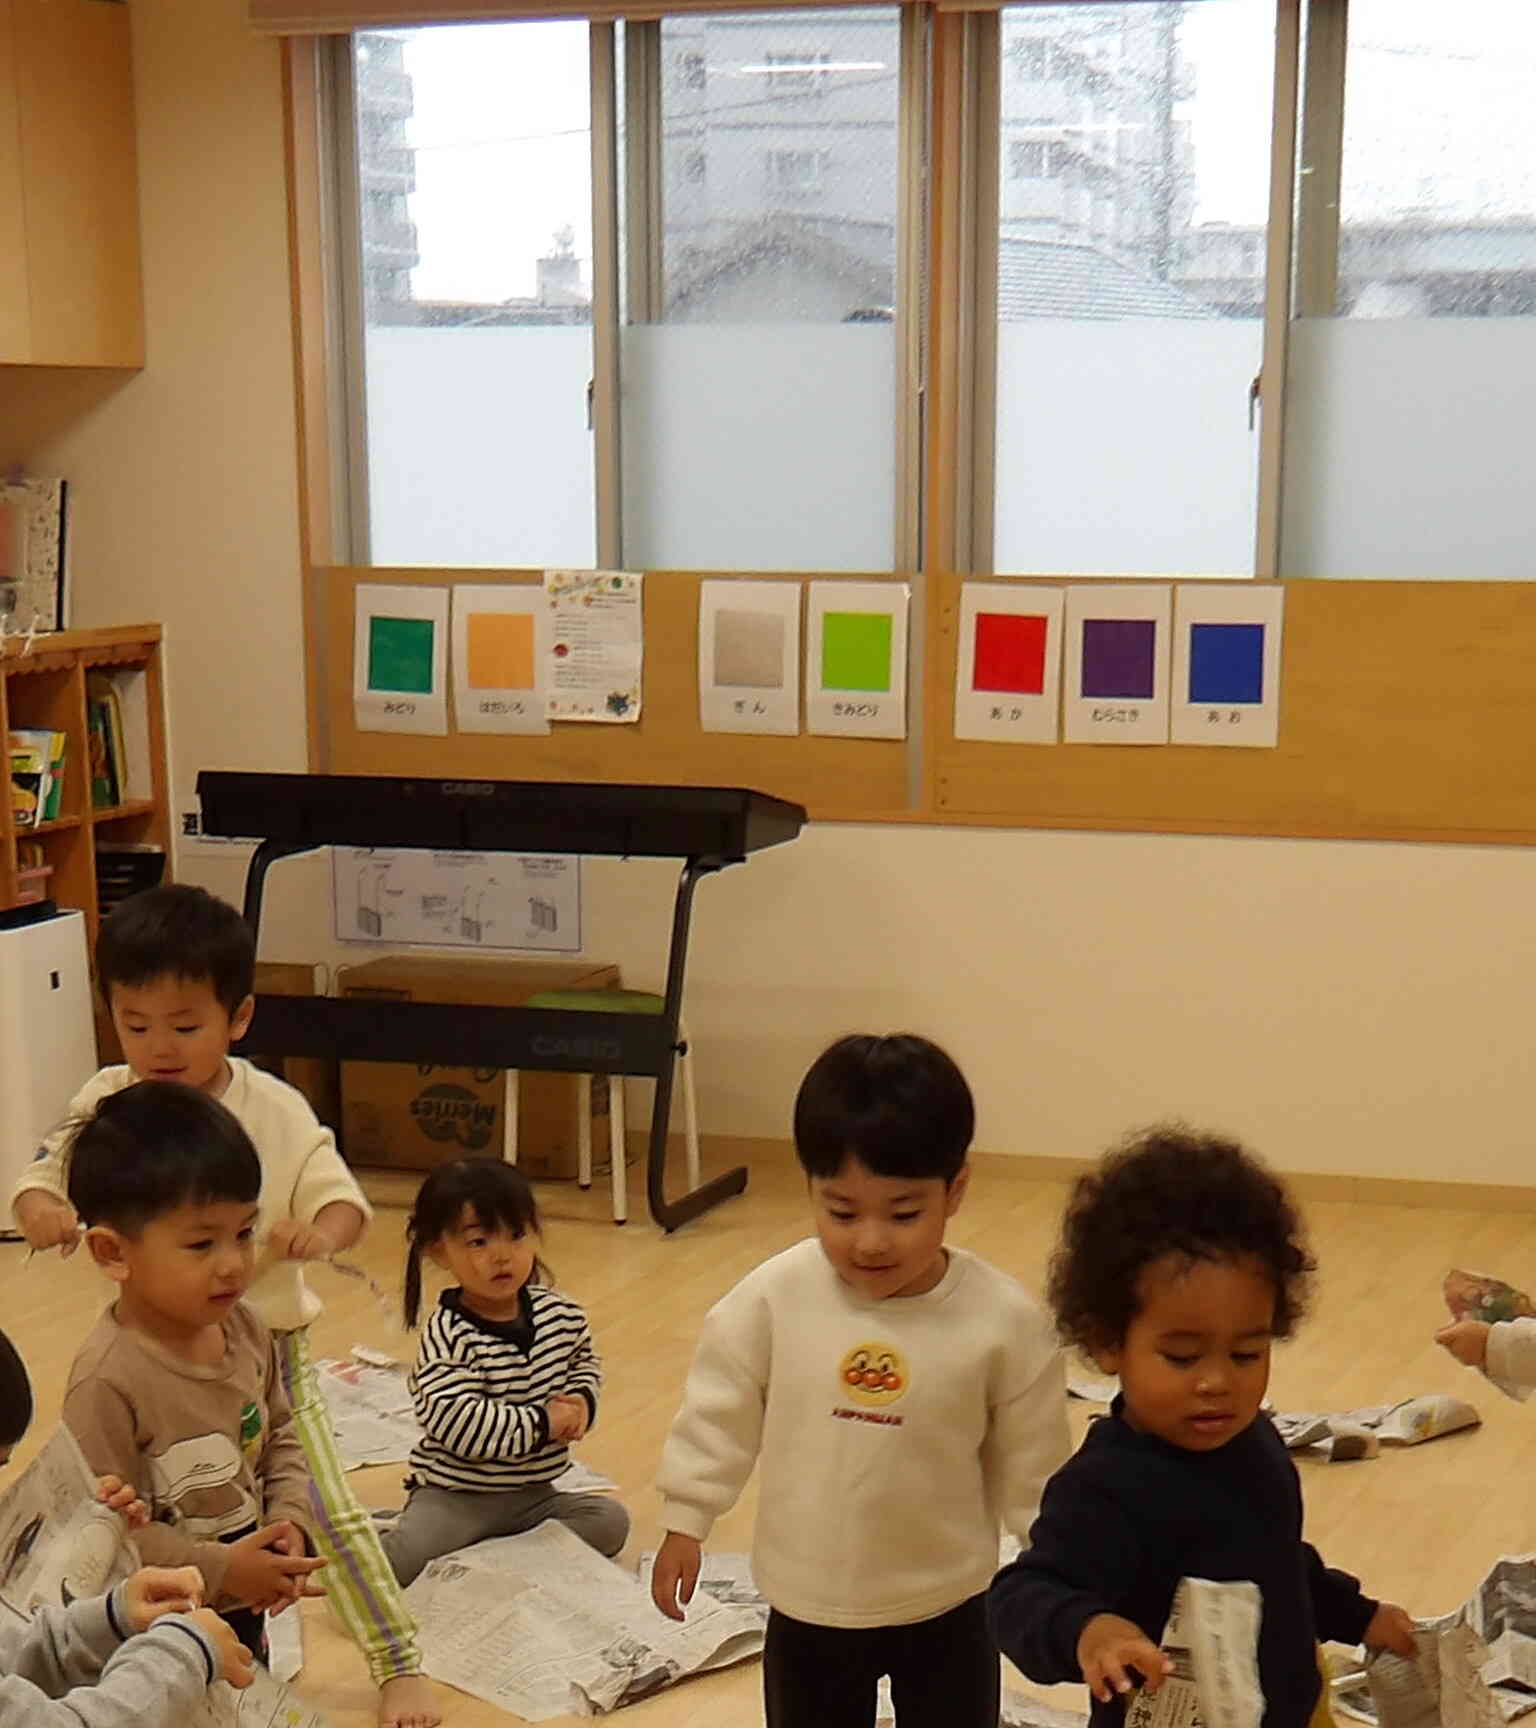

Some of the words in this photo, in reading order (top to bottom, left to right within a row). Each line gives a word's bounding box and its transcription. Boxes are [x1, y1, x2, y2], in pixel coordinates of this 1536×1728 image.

[383, 701, 416, 714] みどり
[479, 701, 526, 714] はだいろ
[832, 703, 880, 717] きみどり
[1091, 708, 1139, 722] むらさき
[441, 782, 495, 796] CASIO
